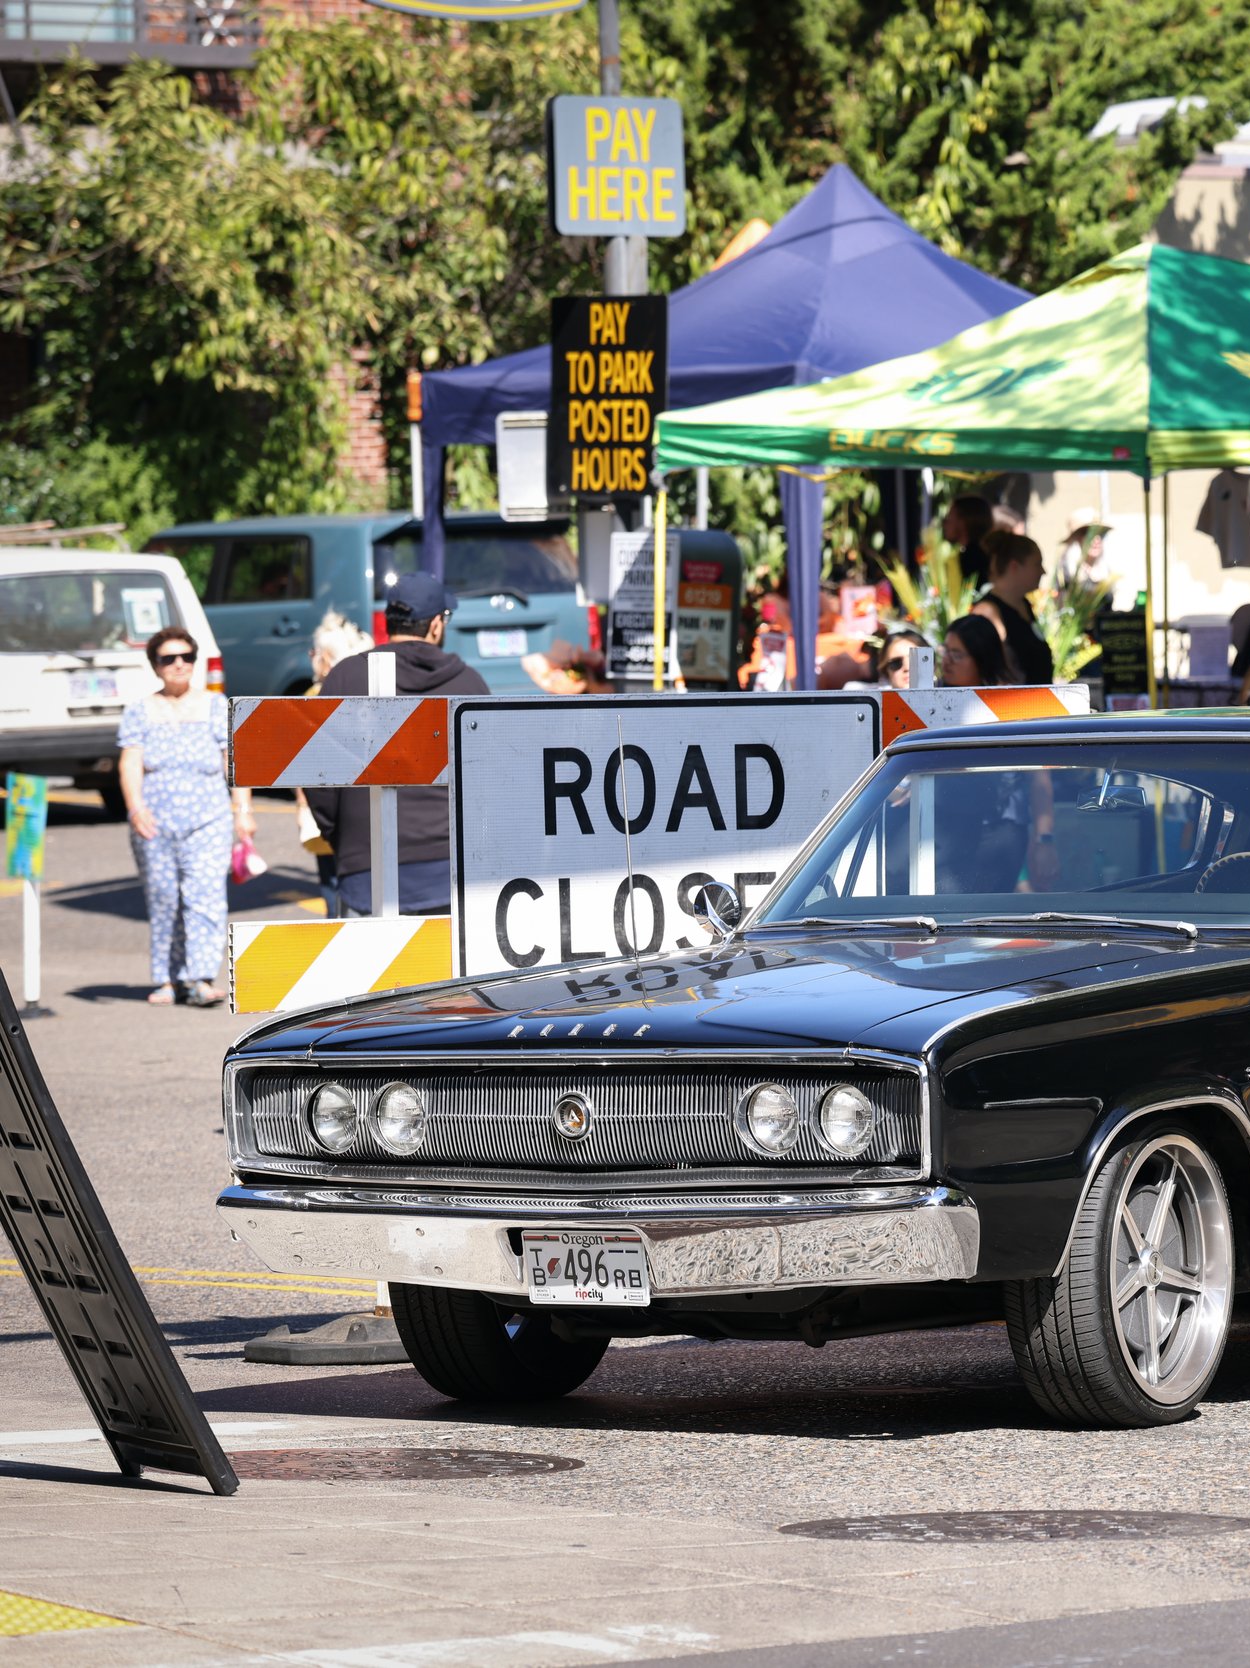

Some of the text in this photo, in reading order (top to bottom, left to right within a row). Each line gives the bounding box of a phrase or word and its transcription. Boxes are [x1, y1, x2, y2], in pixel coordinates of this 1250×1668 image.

[585, 107, 657, 163] PAY
[568, 165, 677, 222] HERE
[589, 302, 630, 346] PAY
[565, 350, 654, 395] TO PARK
[568, 398, 650, 443] POSTED
[829, 428, 958, 456] DUCKS
[571, 447, 647, 492] HOURS
[543, 744, 786, 836] ROAD
[495, 870, 777, 967] CLOSE
[561, 1233, 605, 1248] Oregon
[575, 1288, 604, 1302] ripcity
